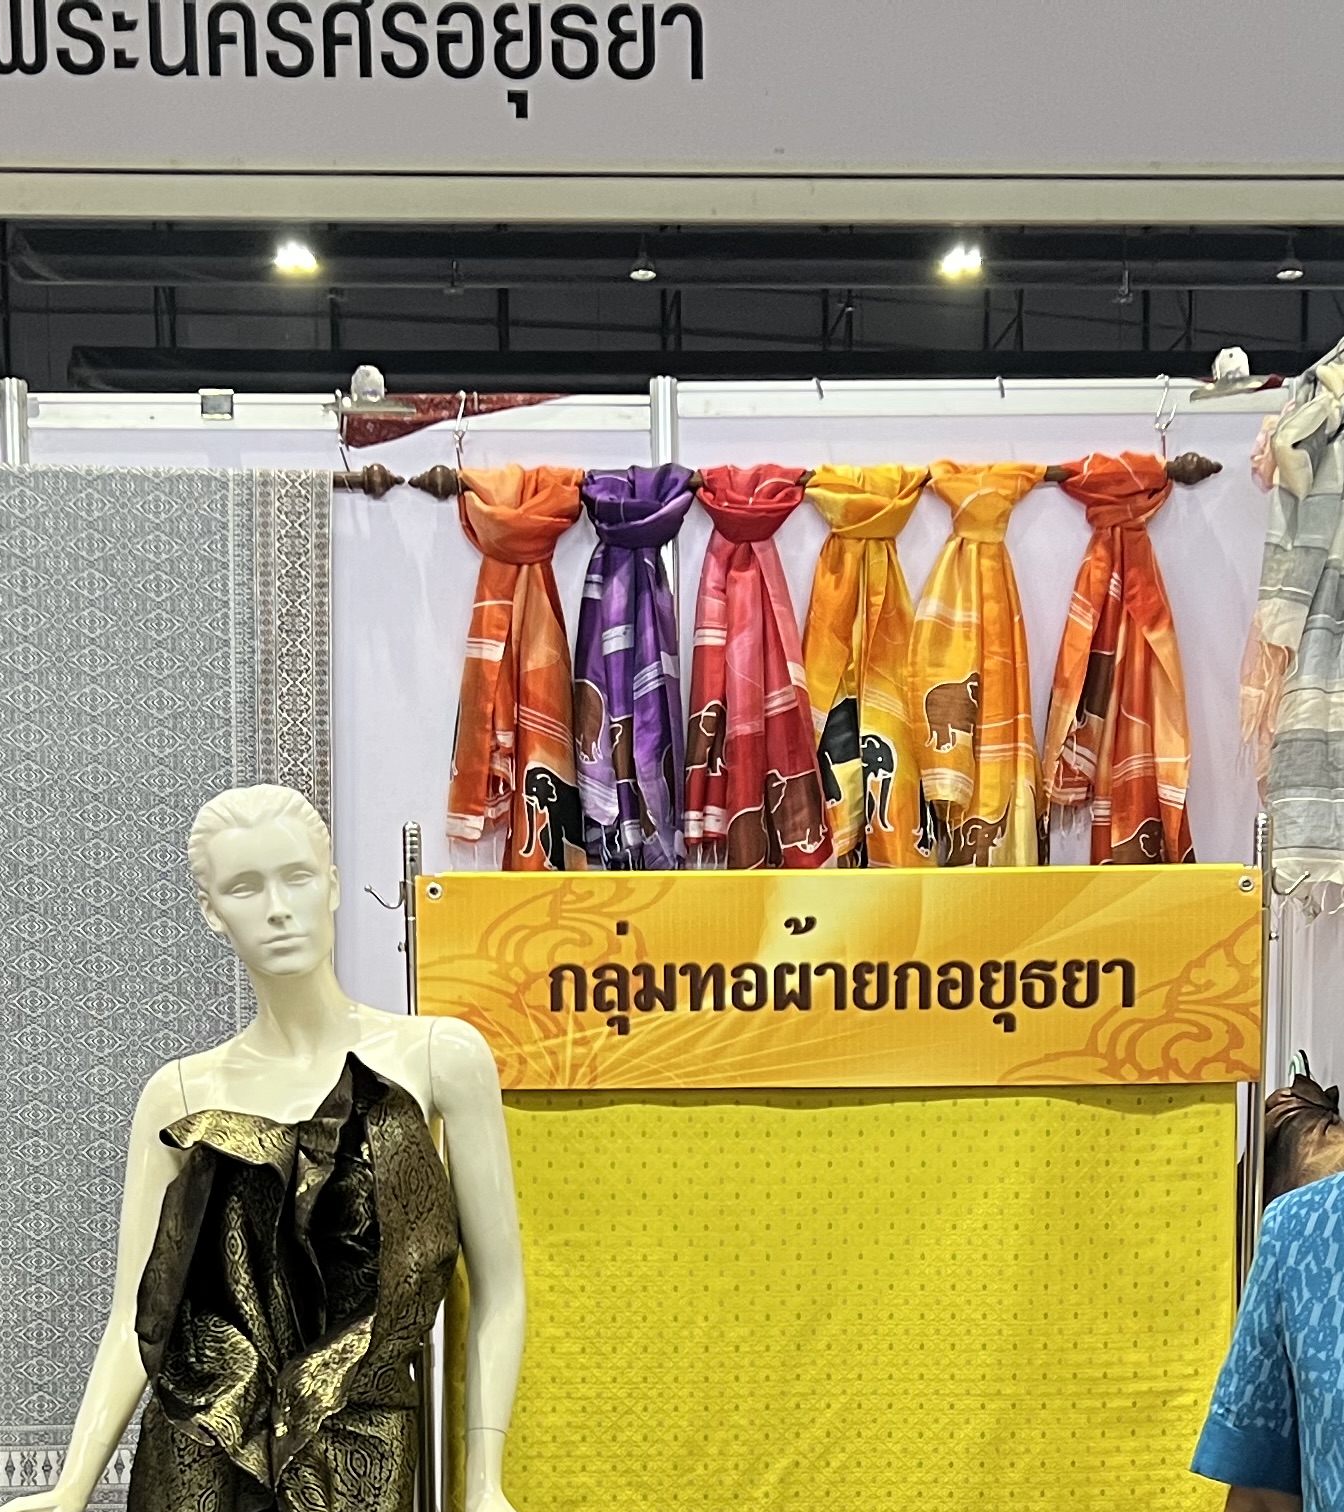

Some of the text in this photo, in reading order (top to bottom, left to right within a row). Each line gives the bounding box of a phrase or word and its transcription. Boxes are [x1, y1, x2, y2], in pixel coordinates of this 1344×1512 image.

[547, 915, 1137, 1035] กลุ่มทอผ้ายกอยุธยา
